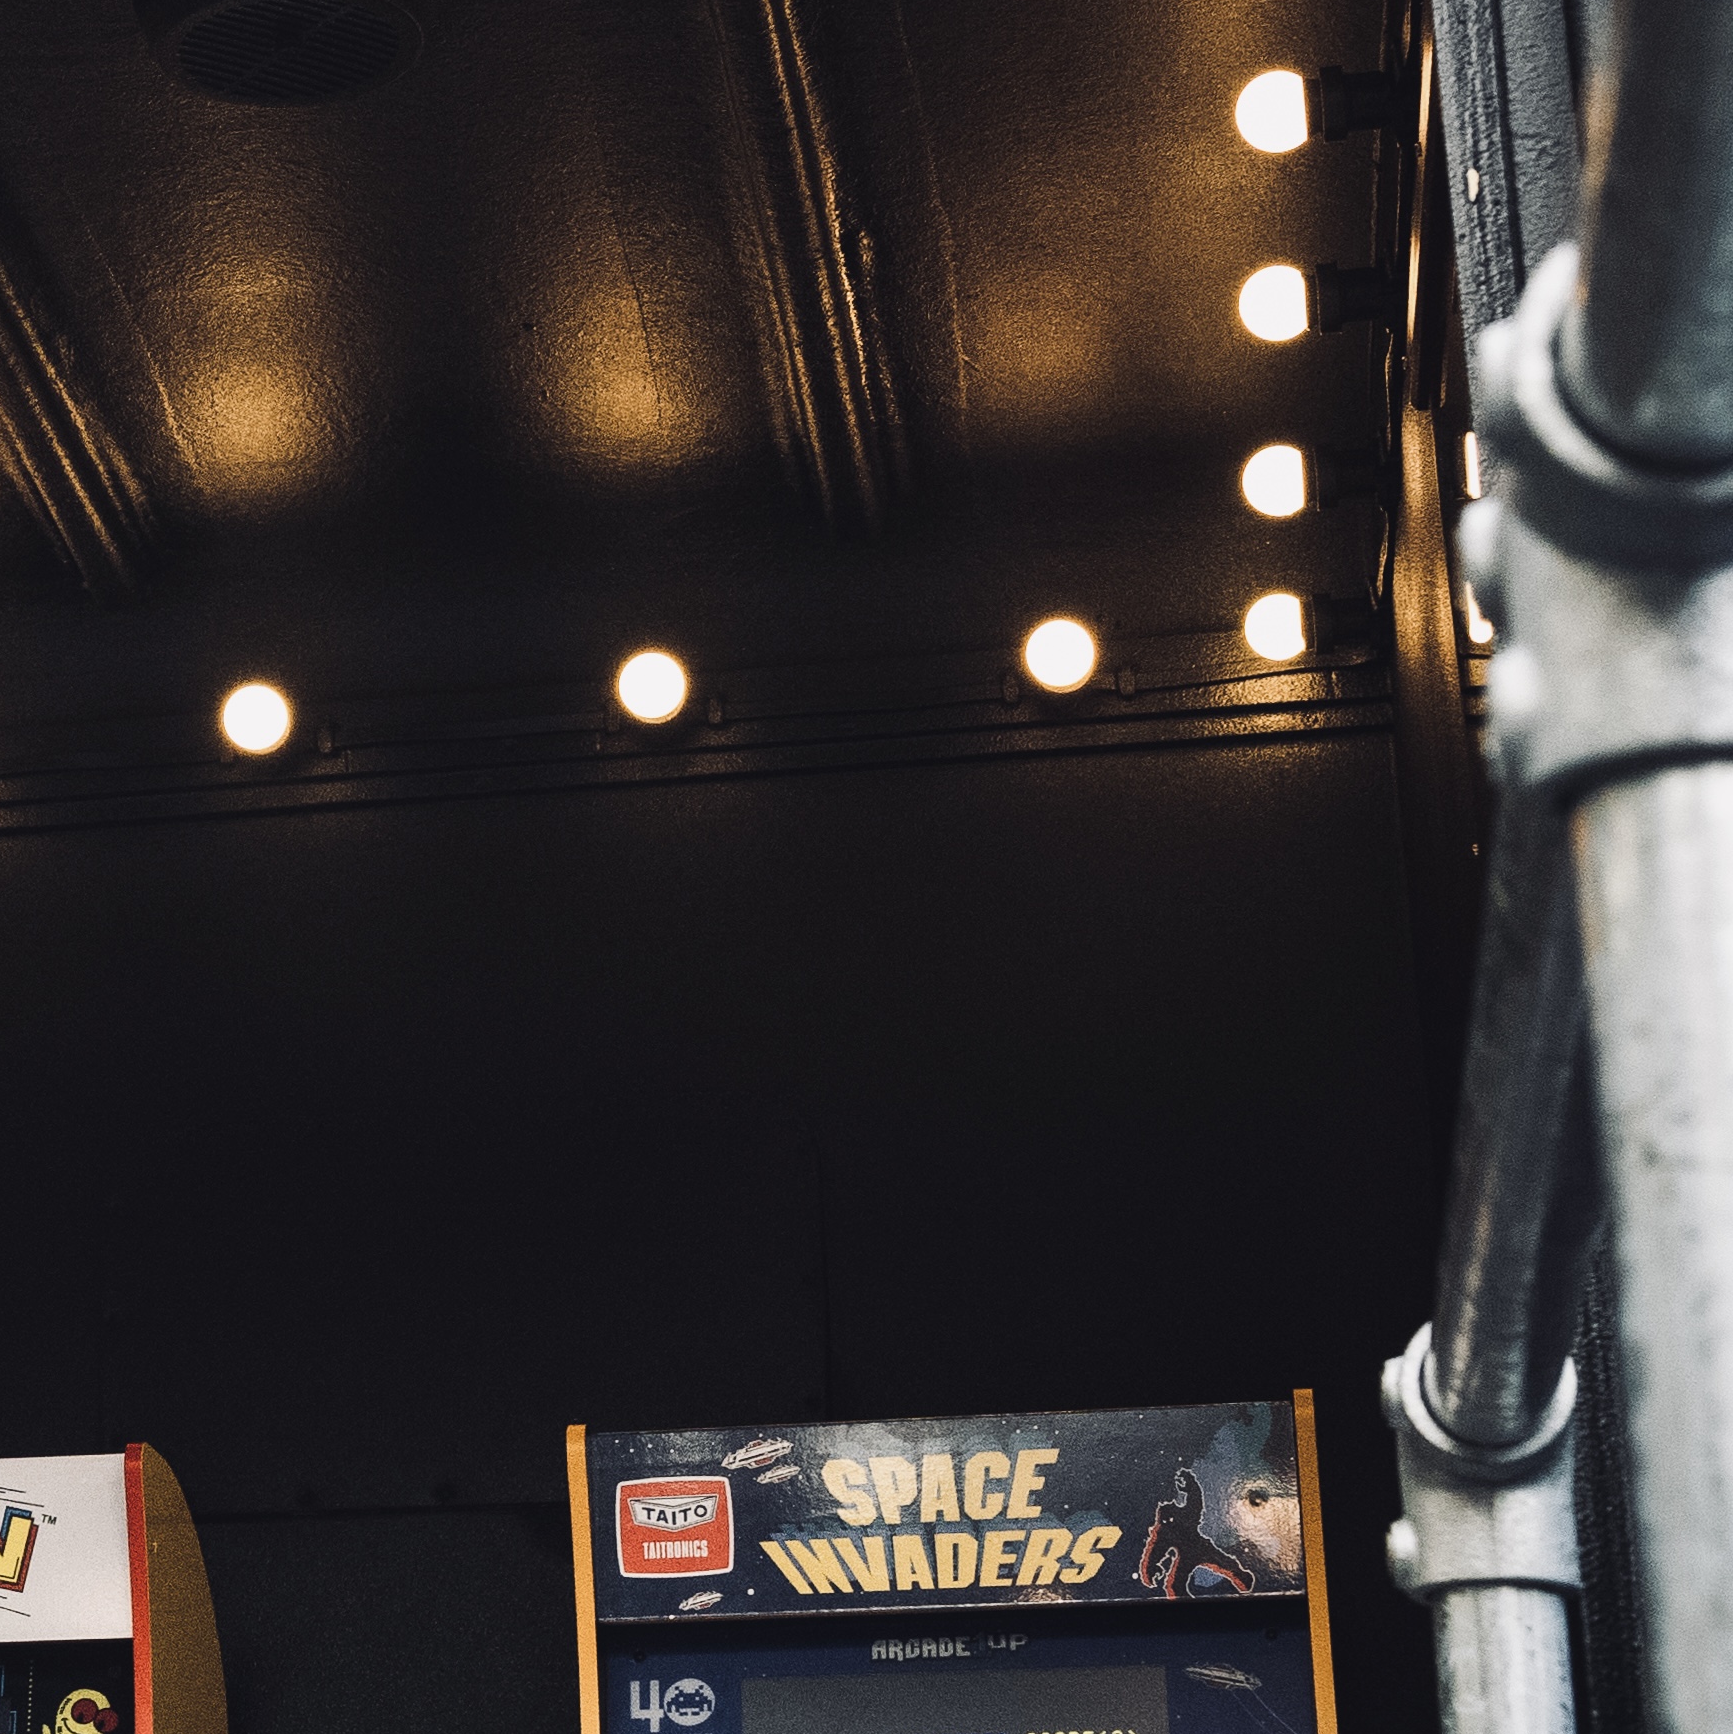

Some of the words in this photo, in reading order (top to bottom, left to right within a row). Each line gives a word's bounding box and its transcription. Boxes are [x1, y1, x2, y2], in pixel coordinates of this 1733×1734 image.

[820, 1447, 1061, 1528] SPACE
[641, 1503, 708, 1527] TAITO
[641, 1538, 709, 1561] TAITRONICS
[759, 1524, 1124, 1596] INVADERS
